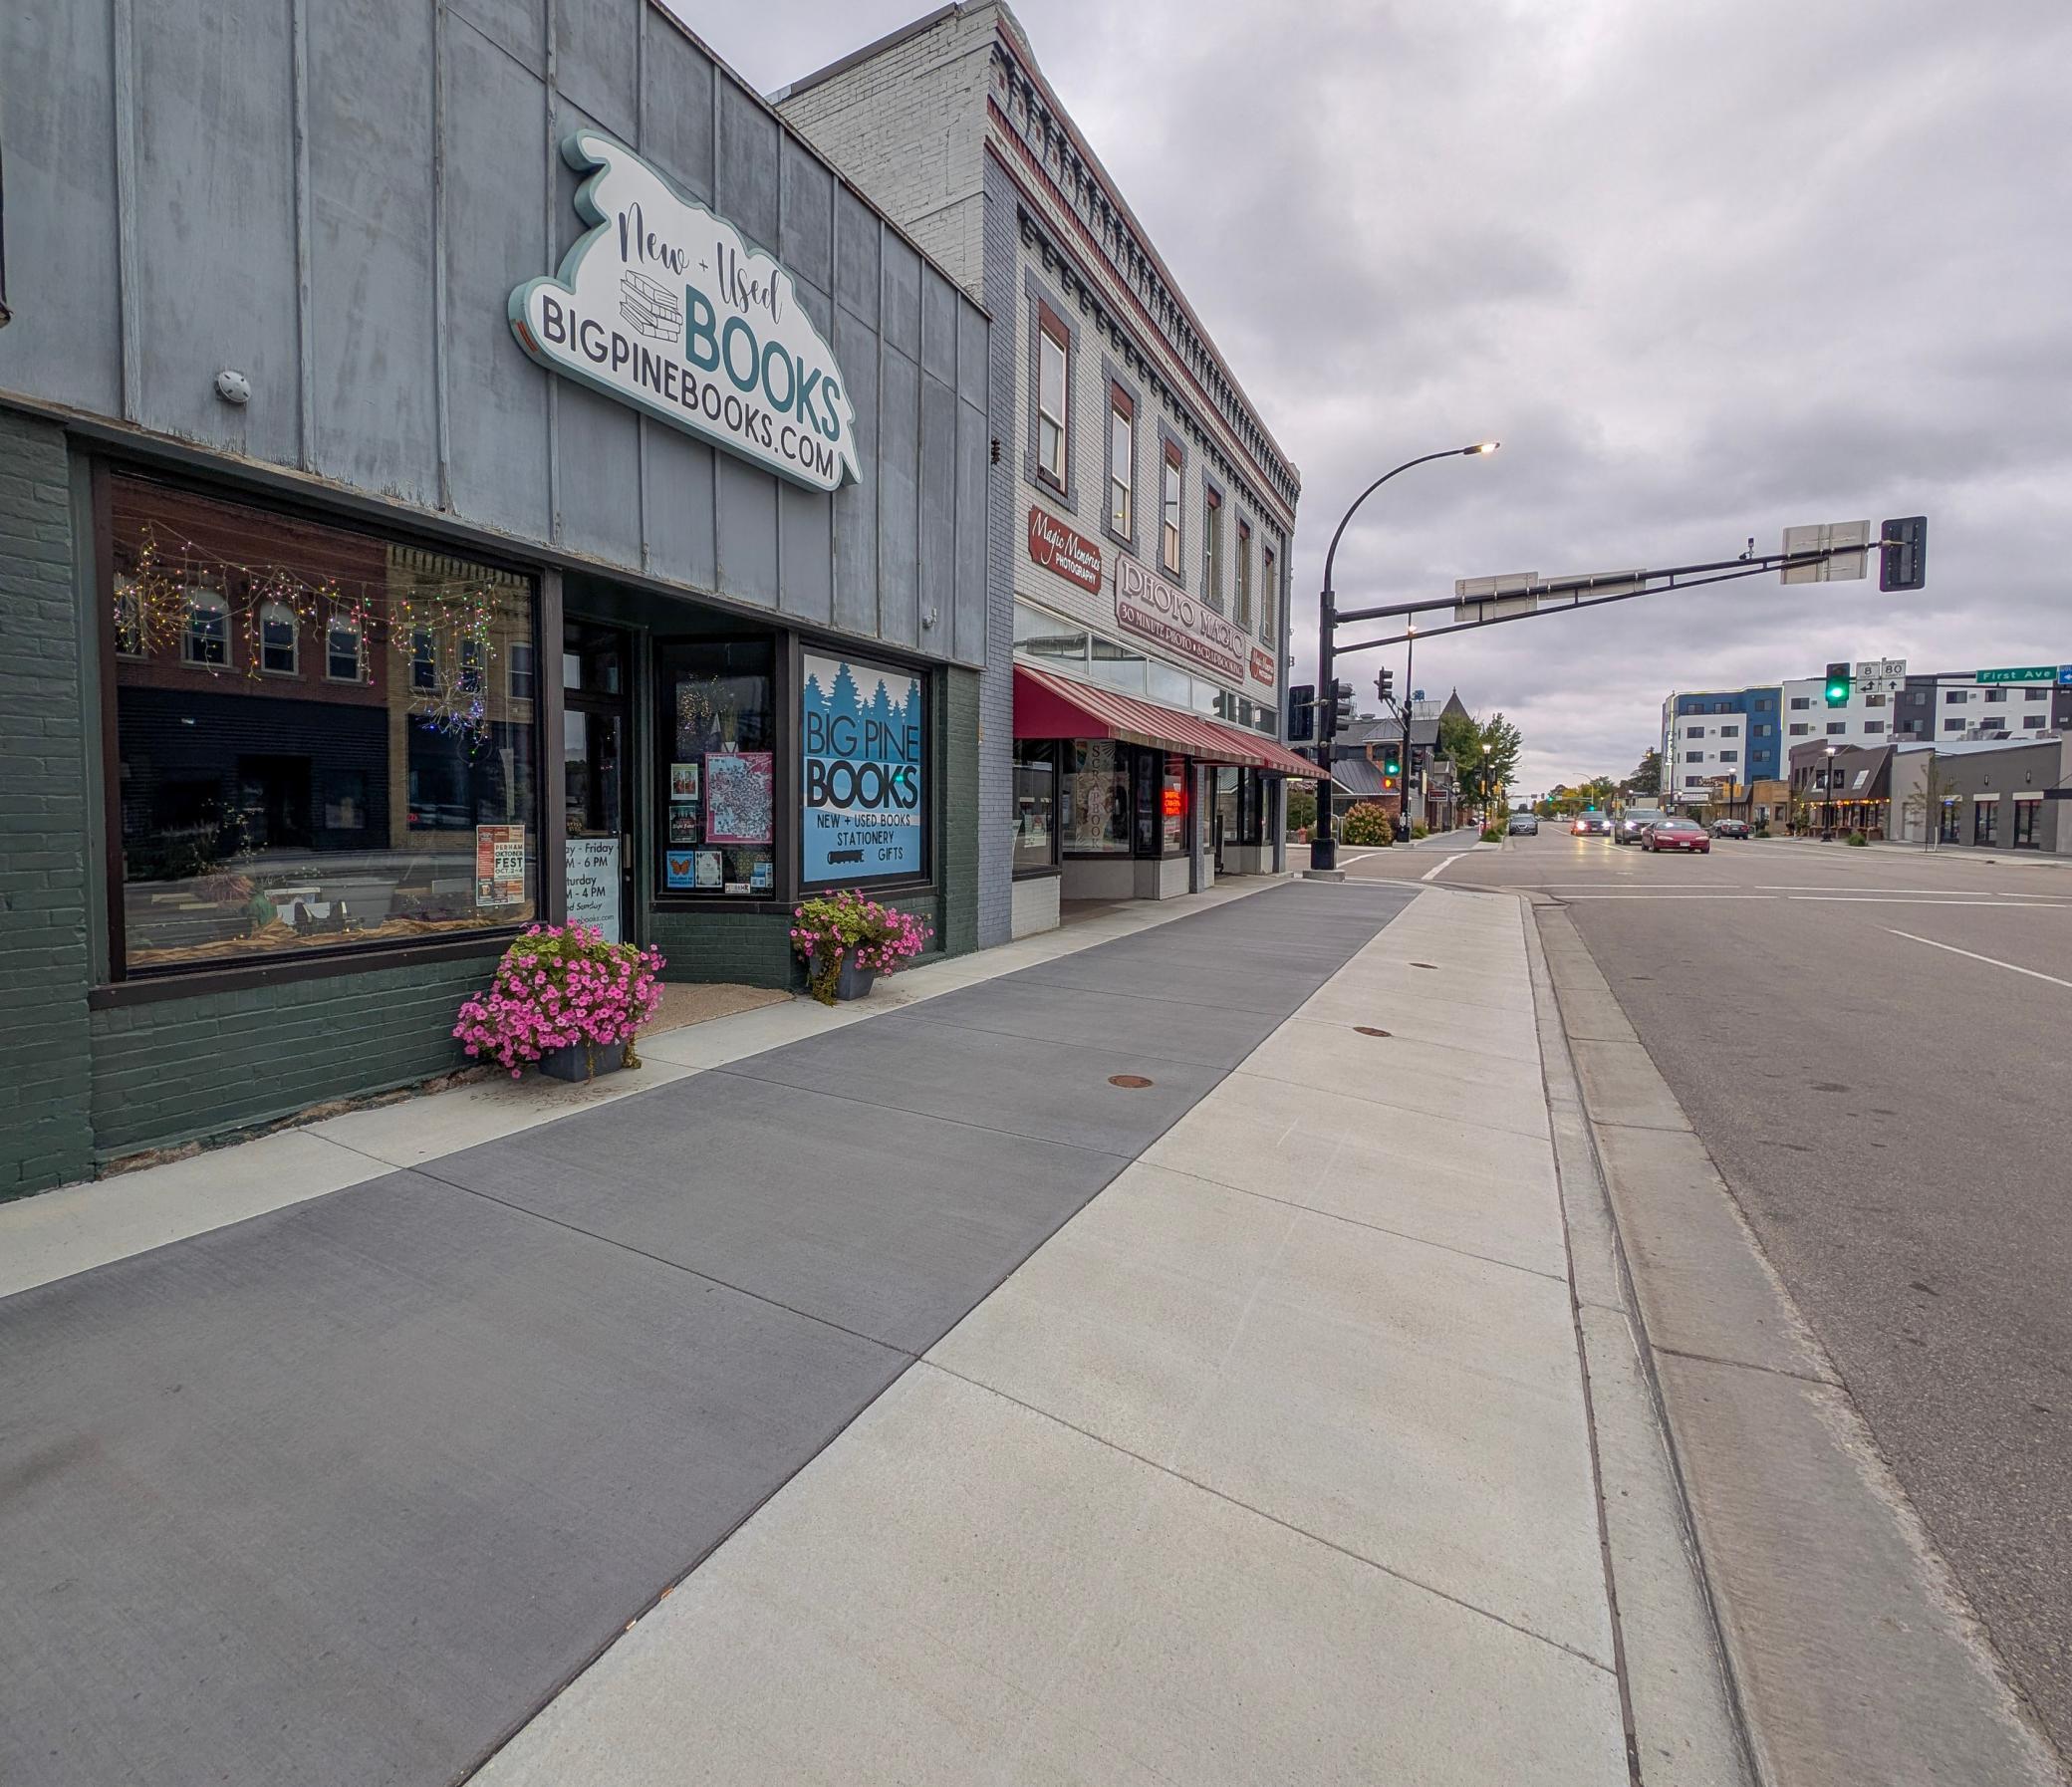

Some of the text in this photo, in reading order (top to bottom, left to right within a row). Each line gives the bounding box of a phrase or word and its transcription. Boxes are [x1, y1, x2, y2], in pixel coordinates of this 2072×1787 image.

[618, 202, 690, 276] New
[716, 241, 782, 325] Used
[684, 283, 841, 442] BOOKS
[542, 294, 834, 480] BIGPINEBOOKS.COM
[1032, 512, 1101, 571] Magic Memories
[1055, 552, 1096, 585] PHOTOGRAPHY
[1123, 561, 1245, 659] PHOTO MAGIC
[1122, 605, 1135, 622] 30
[1136, 611, 1165, 637] MINUTE
[1166, 629, 1192, 650] PHOTO
[1864, 666, 1872, 675] 8
[1885, 664, 1903, 673] 80
[1982, 671, 2016, 680] First
[807, 711, 918, 762] BIG PINE
[806, 758, 918, 809] BOOKS
[817, 814, 841, 829] NEW
[854, 814, 878, 828] USED
[880, 814, 911, 827] BOOKS
[837, 831, 895, 846] STATIONERY
[585, 841, 615, 855] Friday
[878, 847, 904, 861] GIFTS
[495, 858, 523, 869] FEST
[584, 857, 591, 868] 6
[594, 856, 608, 867] PM
[582, 888, 589, 897] 4
[591, 887, 606, 896] PM
